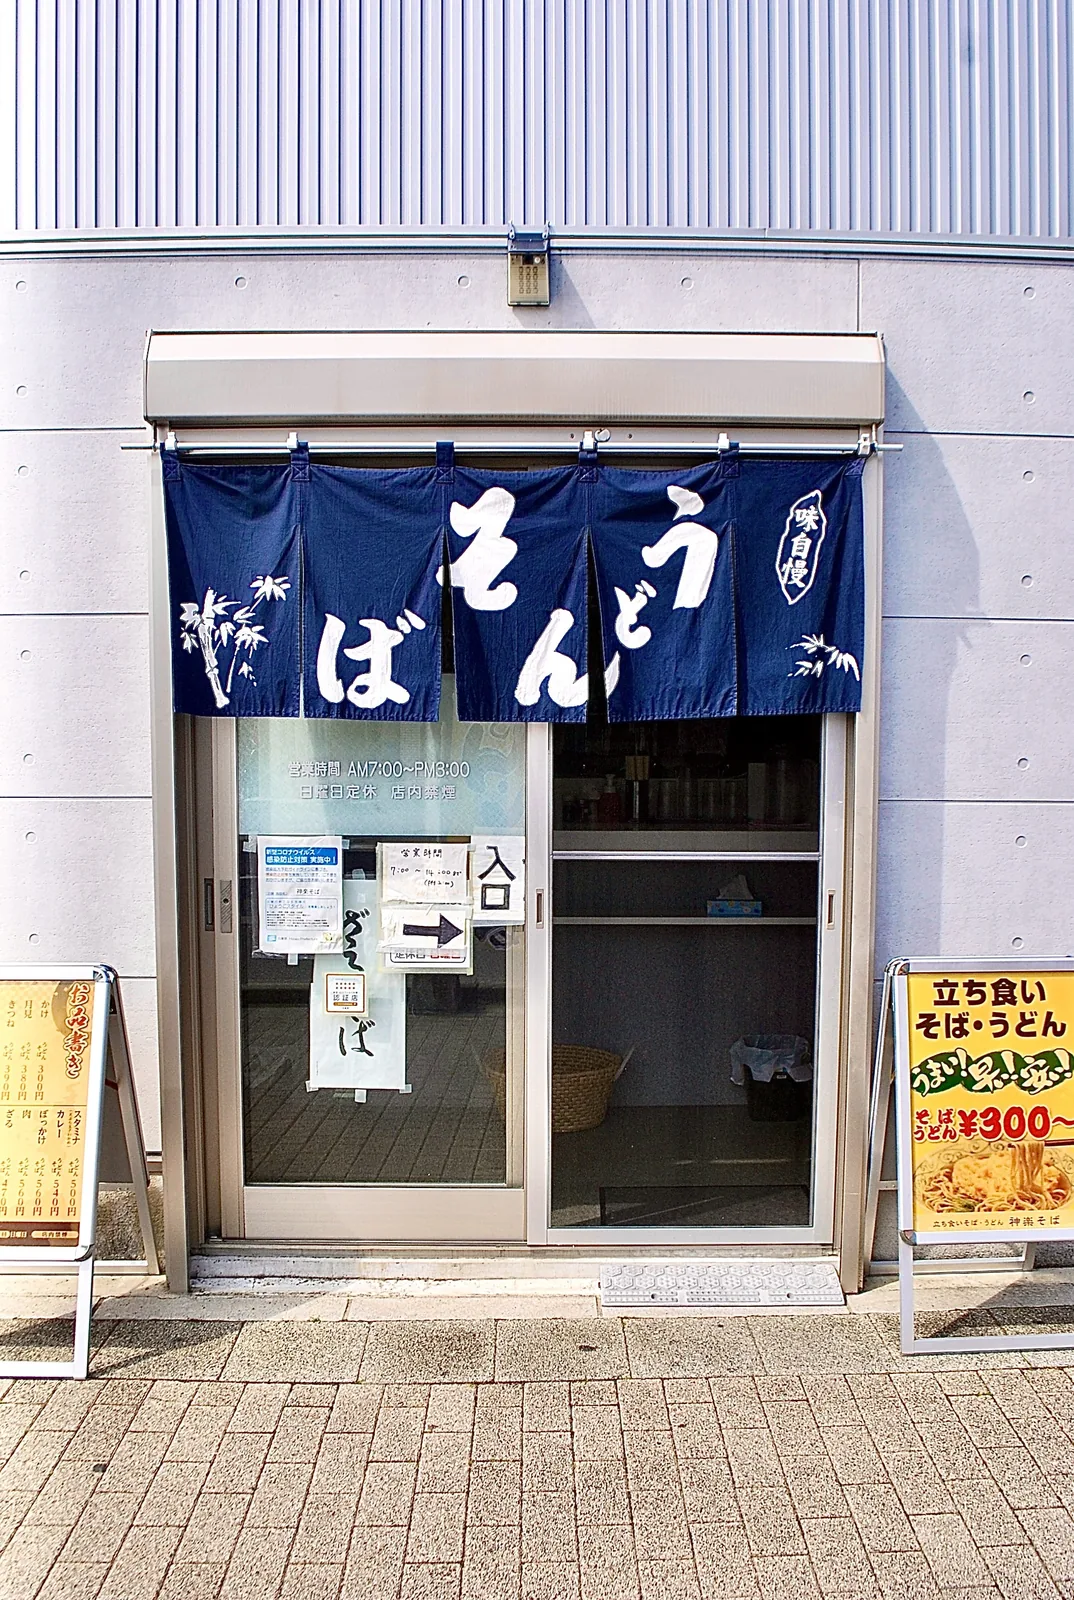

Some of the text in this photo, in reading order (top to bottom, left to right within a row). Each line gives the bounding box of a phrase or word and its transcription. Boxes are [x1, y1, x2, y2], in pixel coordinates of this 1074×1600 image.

[781, 505, 820, 588] 味自慢
[288, 761, 341, 778] 営業時間
[301, 785, 457, 800] 日曜日定休 店内禁煙
[400, 847, 443, 859] 営業時間
[477, 845, 517, 910] 入口
[933, 978, 1046, 1006] 立ち食い
[7, 1000, 16, 1028] きつね
[24, 1000, 33, 1019] 月見
[41, 1000, 50, 1018] かけ
[65, 983, 89, 1078] お品書き
[916, 1011, 1067, 1039] そば・うどん
[57, 1109, 65, 1138] カレー
[72, 1110, 82, 1146] スタミナ
[916, 1108, 953, 1124] そば
[913, 1125, 957, 1141] うどん
[67, 1179, 77, 1216] 500円
[1008, 1215, 1061, 1227] 神楽そば
